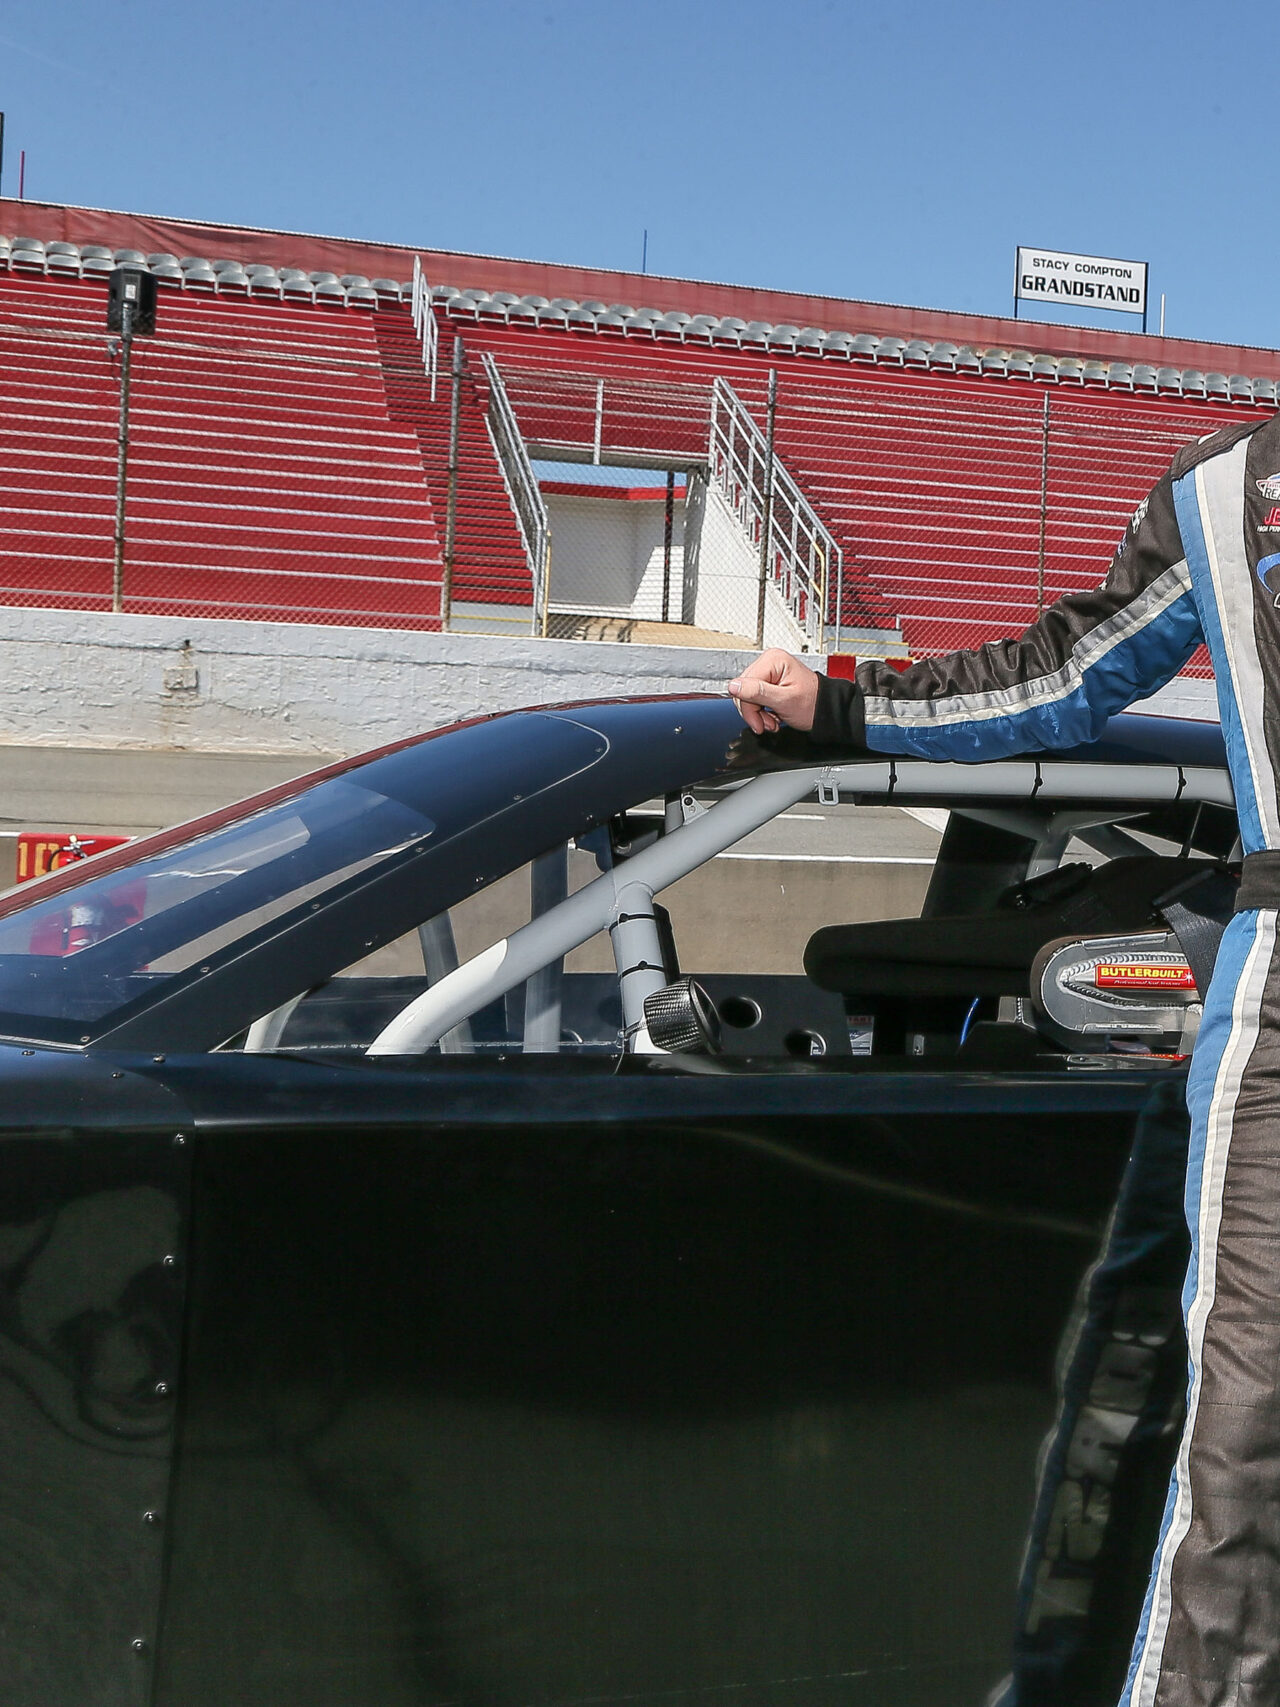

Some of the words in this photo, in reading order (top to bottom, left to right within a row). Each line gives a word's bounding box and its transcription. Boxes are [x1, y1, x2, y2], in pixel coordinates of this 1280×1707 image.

[1033, 258, 1070, 271] STACY
[1075, 263, 1132, 279] COMPTON
[1022, 275, 1139, 303] GRANDSTAND
[1101, 968, 1184, 978] BUTLERBUILT
